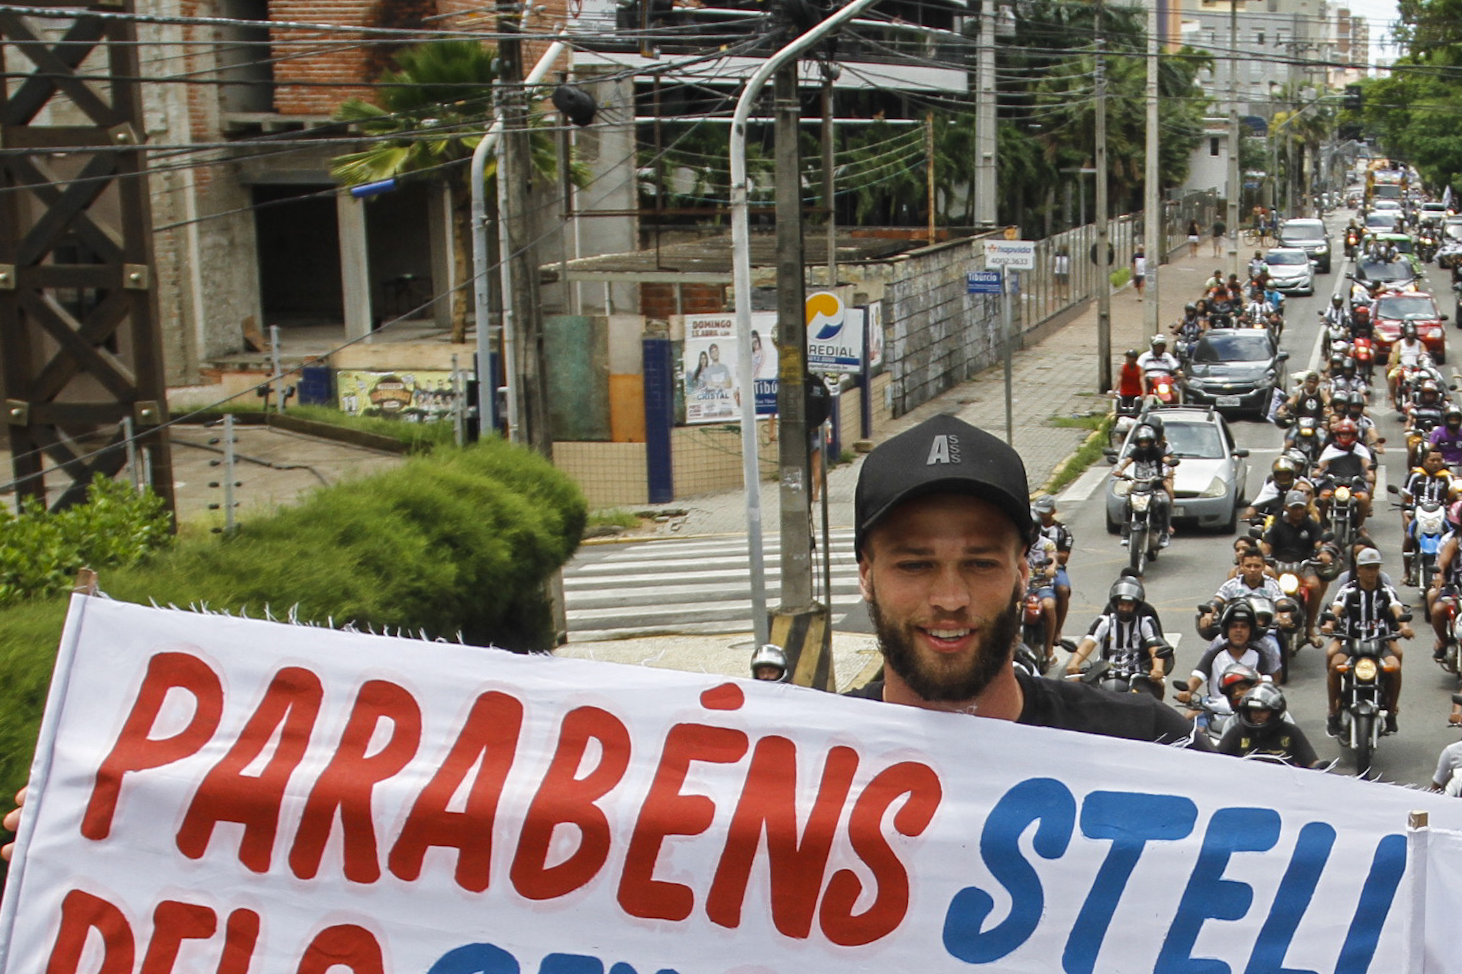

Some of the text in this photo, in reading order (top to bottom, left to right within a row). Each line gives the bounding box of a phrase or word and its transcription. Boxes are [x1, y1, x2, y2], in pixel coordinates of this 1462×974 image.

[997, 245, 1032, 254] hapvida
[692, 319, 732, 330] DOMINGO
[80, 651, 943, 947] PARABÉNS
